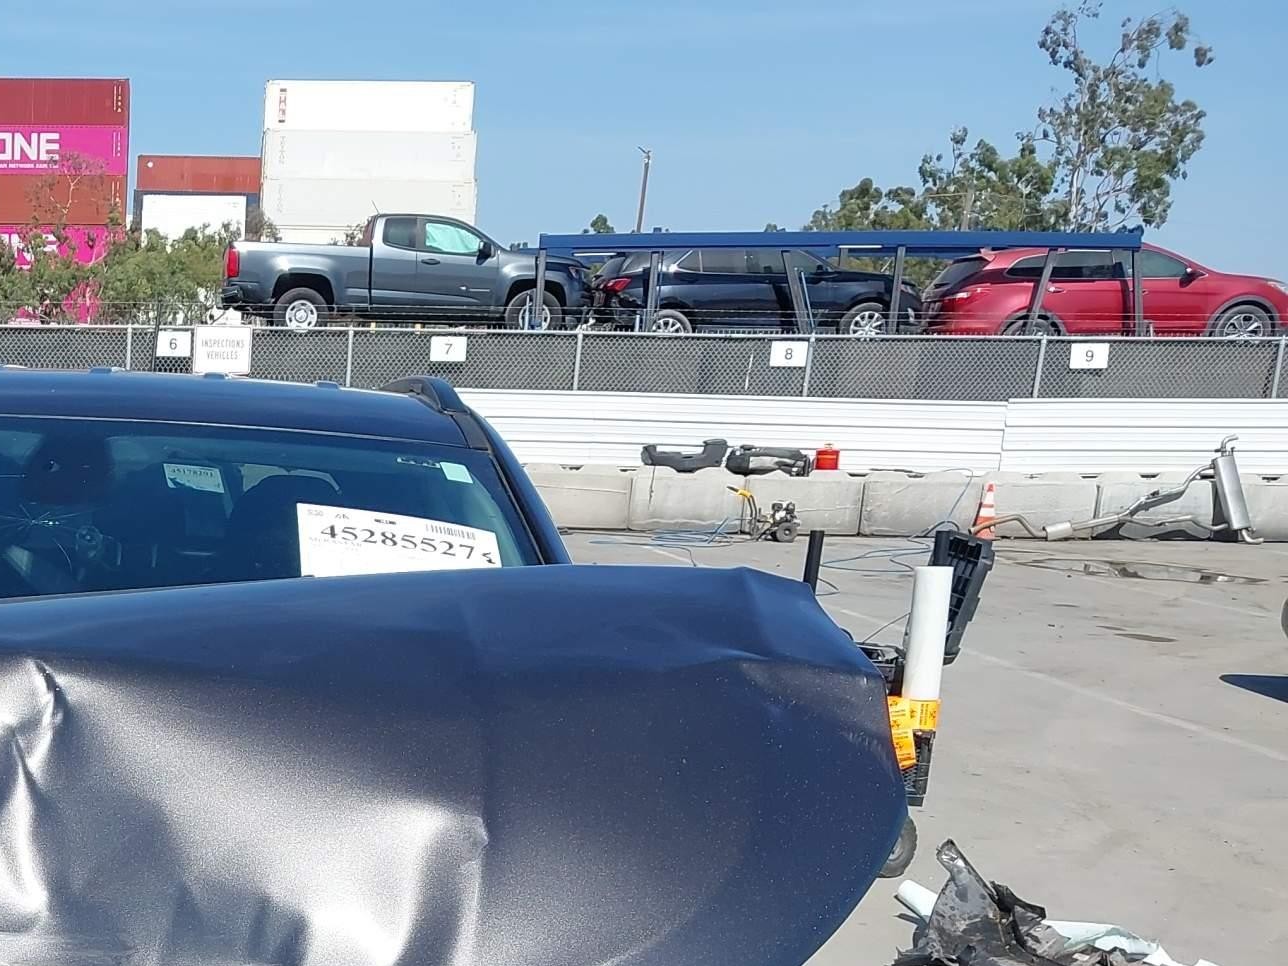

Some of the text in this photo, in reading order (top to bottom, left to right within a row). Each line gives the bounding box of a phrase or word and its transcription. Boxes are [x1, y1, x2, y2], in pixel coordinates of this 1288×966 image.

[169, 338, 178, 350] 6
[201, 339, 245, 348] INSPECTIONS
[444, 343, 453, 355] 7
[206, 351, 239, 360] VEHICLES
[785, 348, 793, 360] 8
[1085, 350, 1094, 362] 9
[320, 524, 475, 560] 45285527
